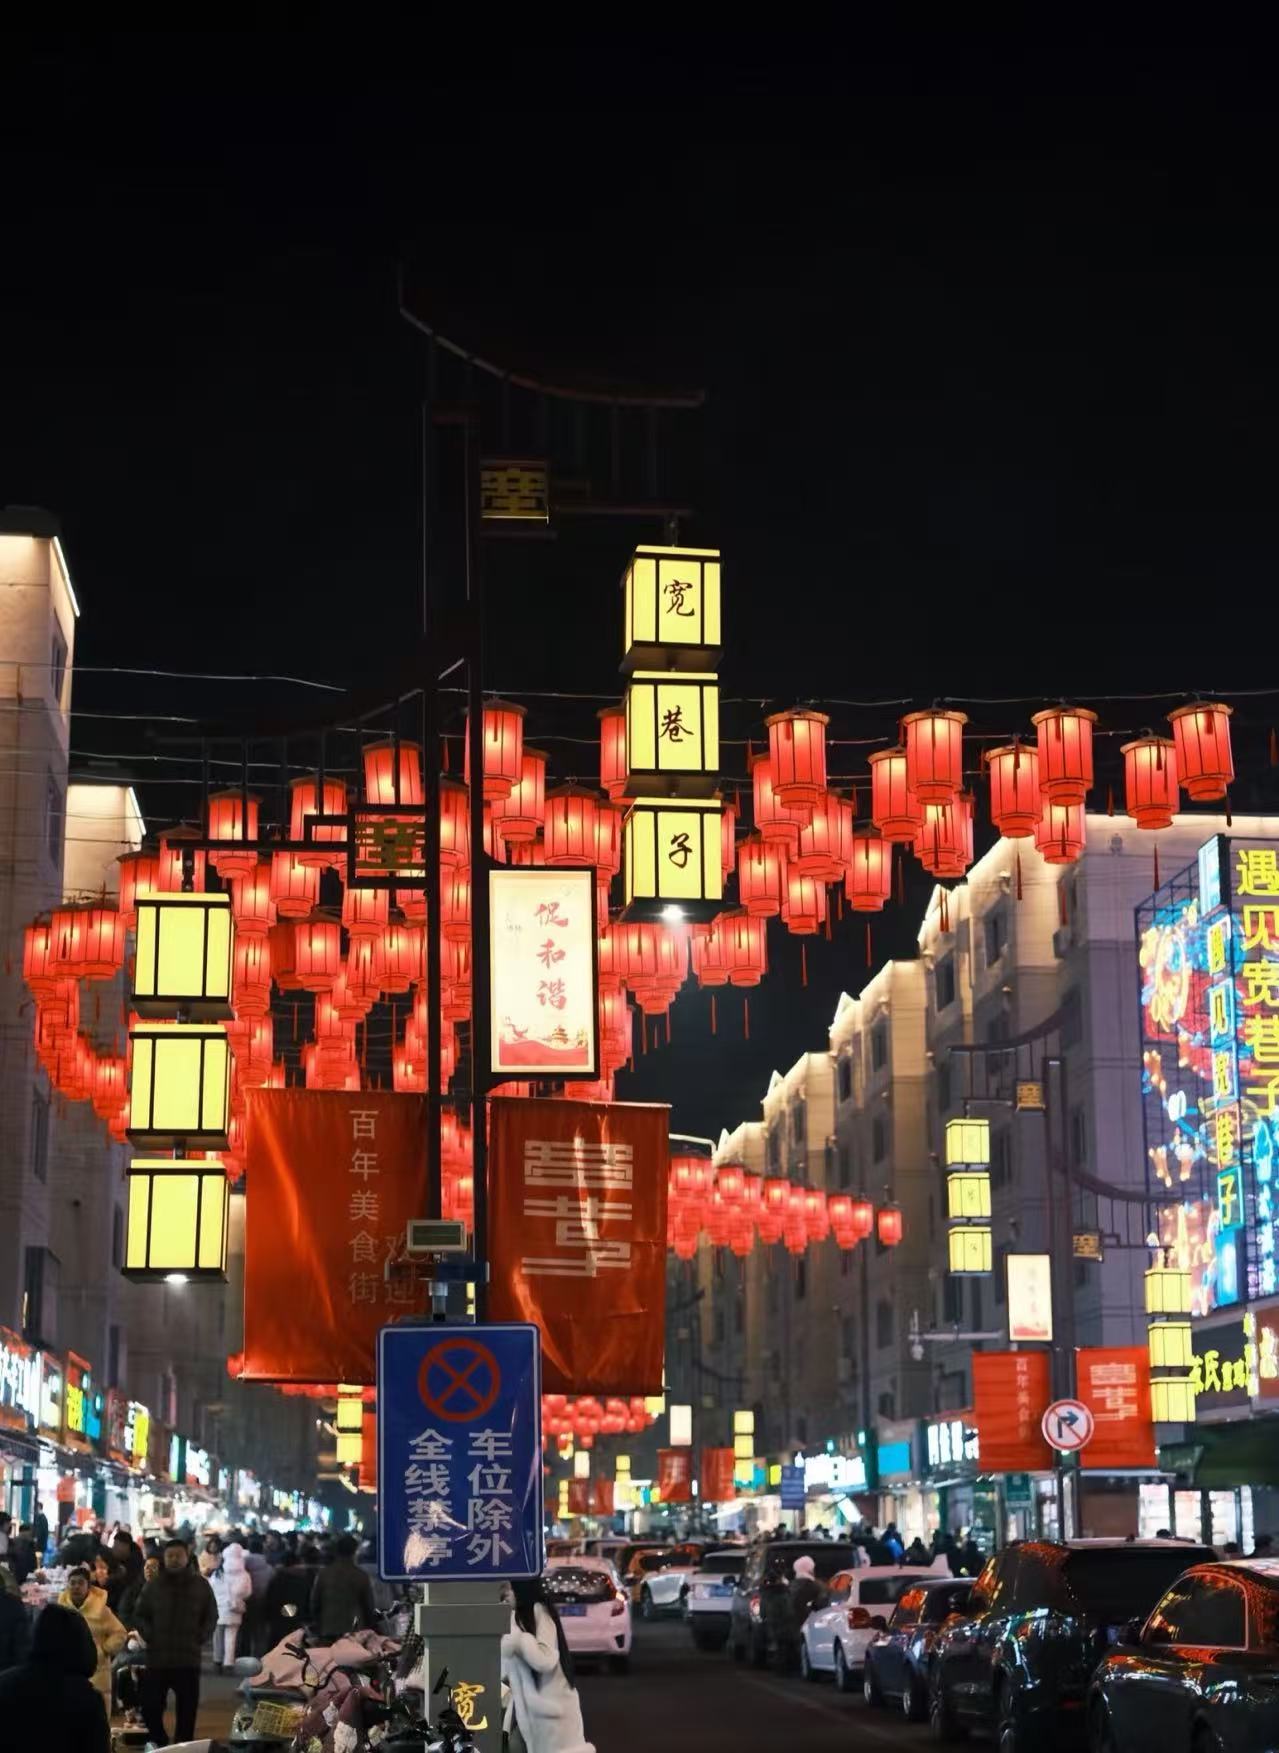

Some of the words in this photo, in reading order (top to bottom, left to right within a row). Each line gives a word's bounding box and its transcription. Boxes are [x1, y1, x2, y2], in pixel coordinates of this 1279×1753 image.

[1236, 849, 1279, 1116] 遇见宽巷子
[348, 1109, 380, 1305] 百年美食街
[404, 1428, 454, 1567] 全线禁停
[466, 1428, 513, 1567] 车位除外
